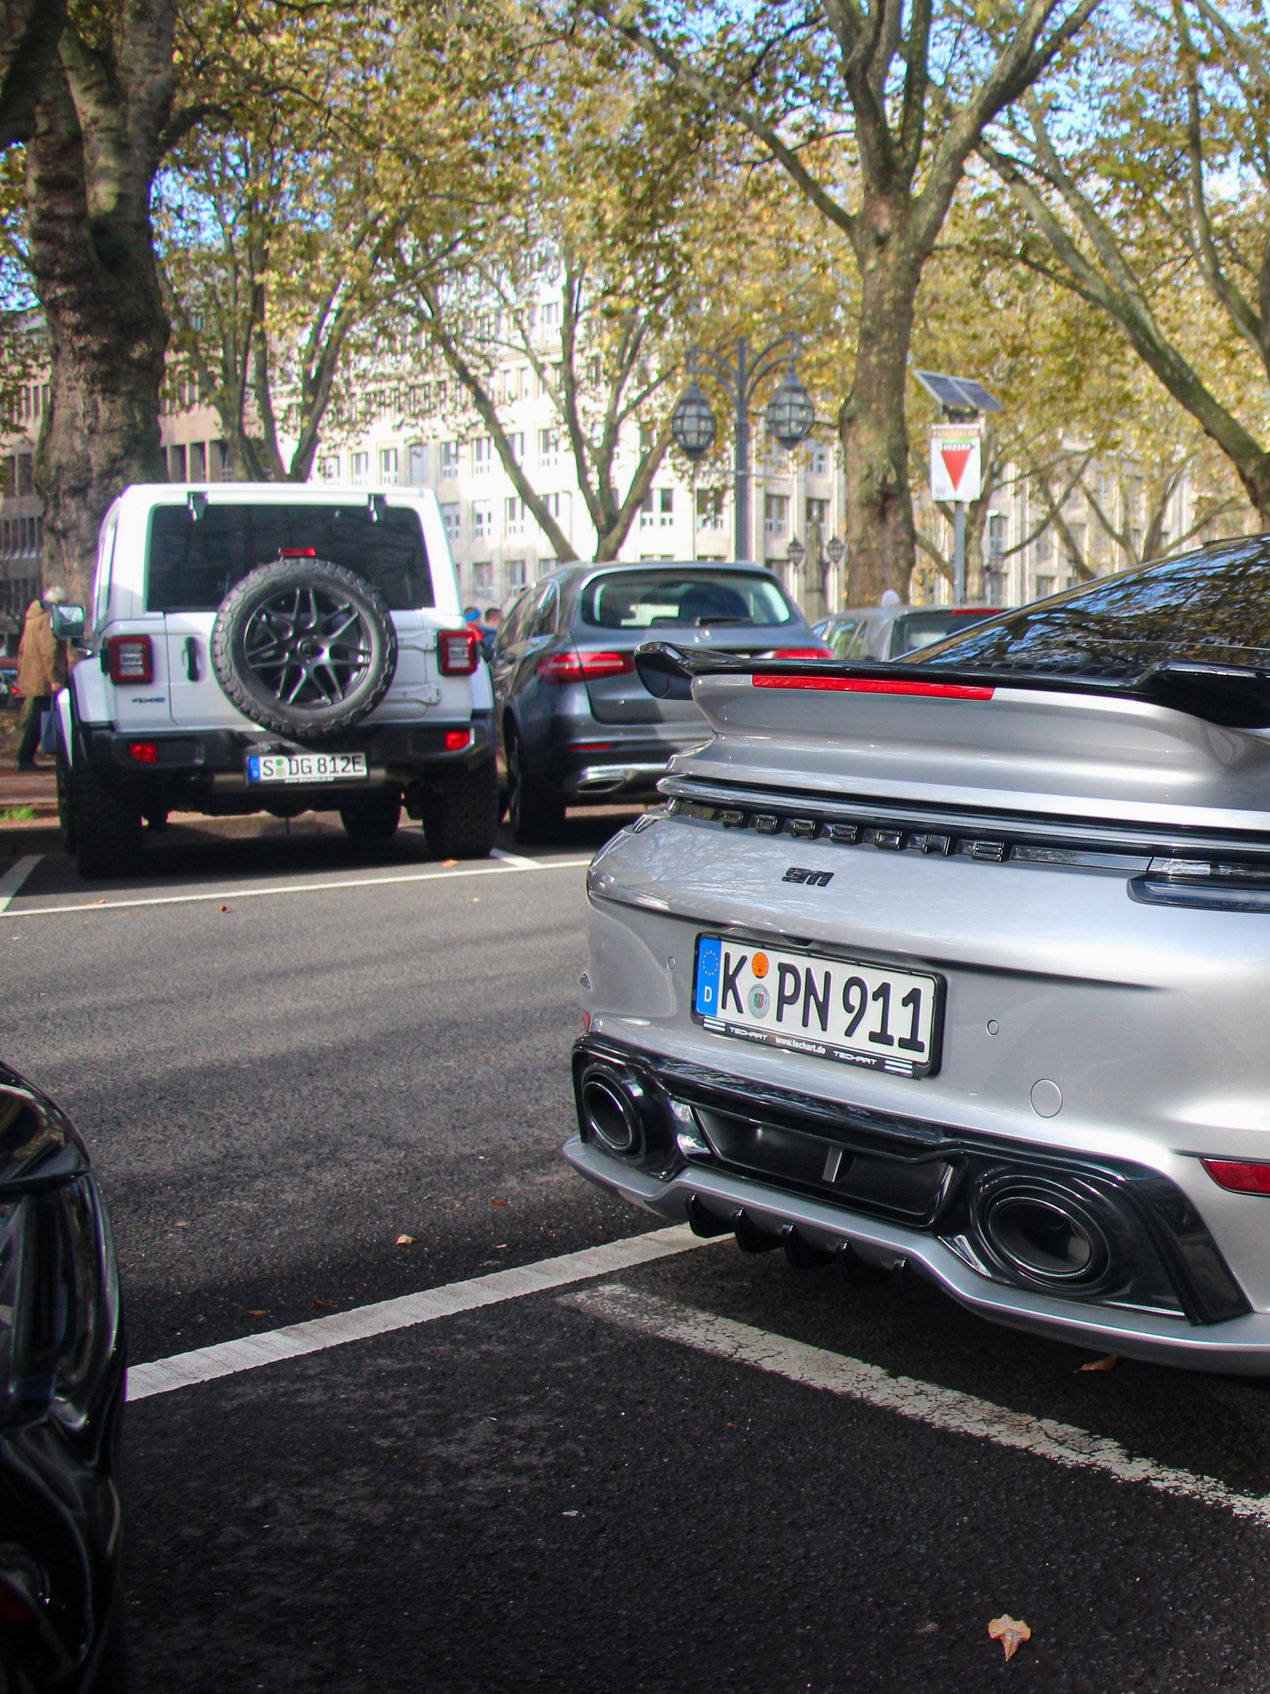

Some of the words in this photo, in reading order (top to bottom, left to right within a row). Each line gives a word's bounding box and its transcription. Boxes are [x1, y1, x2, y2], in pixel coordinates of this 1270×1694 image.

[262, 759, 274, 777] S
[288, 758, 312, 776] DG
[317, 755, 364, 775] 812E
[721, 810, 1006, 862] PORSCHE
[781, 866, 835, 888] 911
[703, 985, 713, 1003] D
[722, 952, 748, 1013] K
[775, 962, 833, 1032] PN
[842, 976, 926, 1053] 911
[729, 1026, 768, 1041] TECHART
[775, 1036, 827, 1055] www.techart.de
[833, 1050, 878, 1065] TECHART
